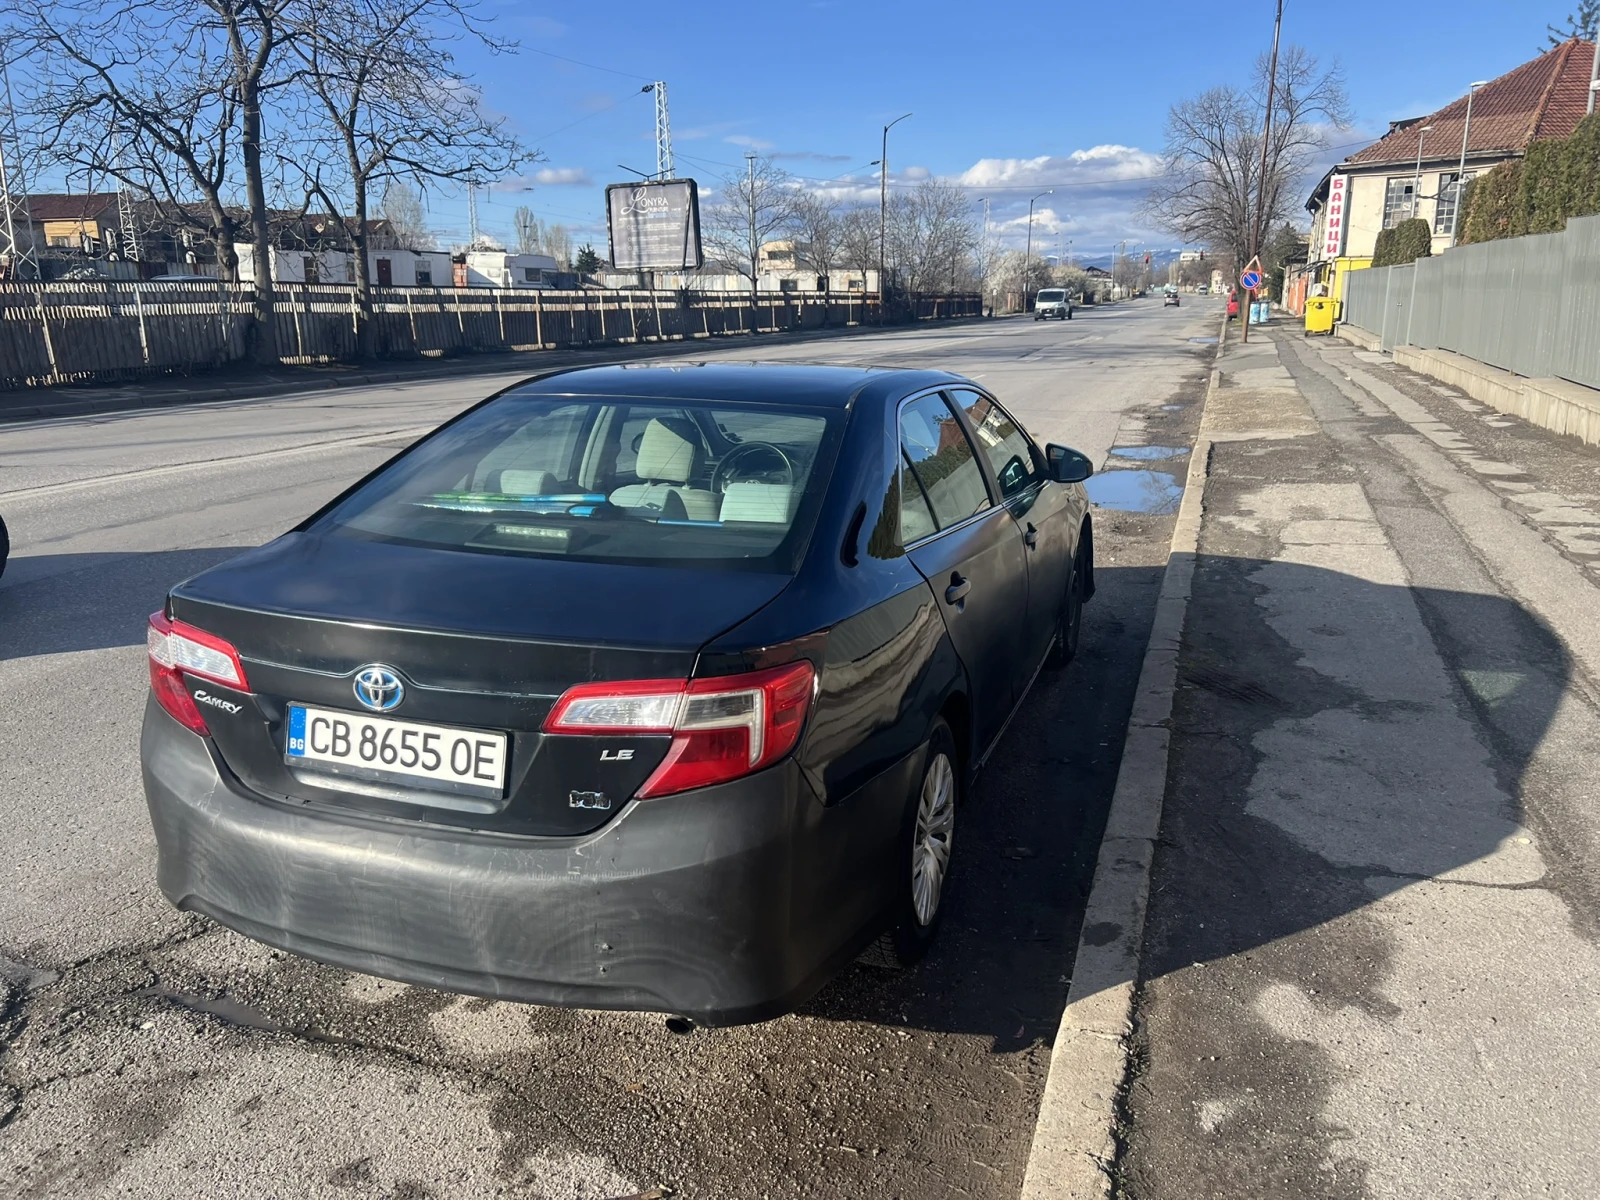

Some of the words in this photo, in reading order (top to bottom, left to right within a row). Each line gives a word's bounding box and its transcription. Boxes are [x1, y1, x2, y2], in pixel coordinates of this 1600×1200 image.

[1326, 178, 1344, 254] БАНИЦИ
[193, 689, 243, 714] CAMRY
[289, 737, 304, 750] BG
[310, 717, 351, 757] CB
[358, 724, 442, 772] 8655
[450, 737, 497, 781] OE
[599, 749, 636, 761] LE
